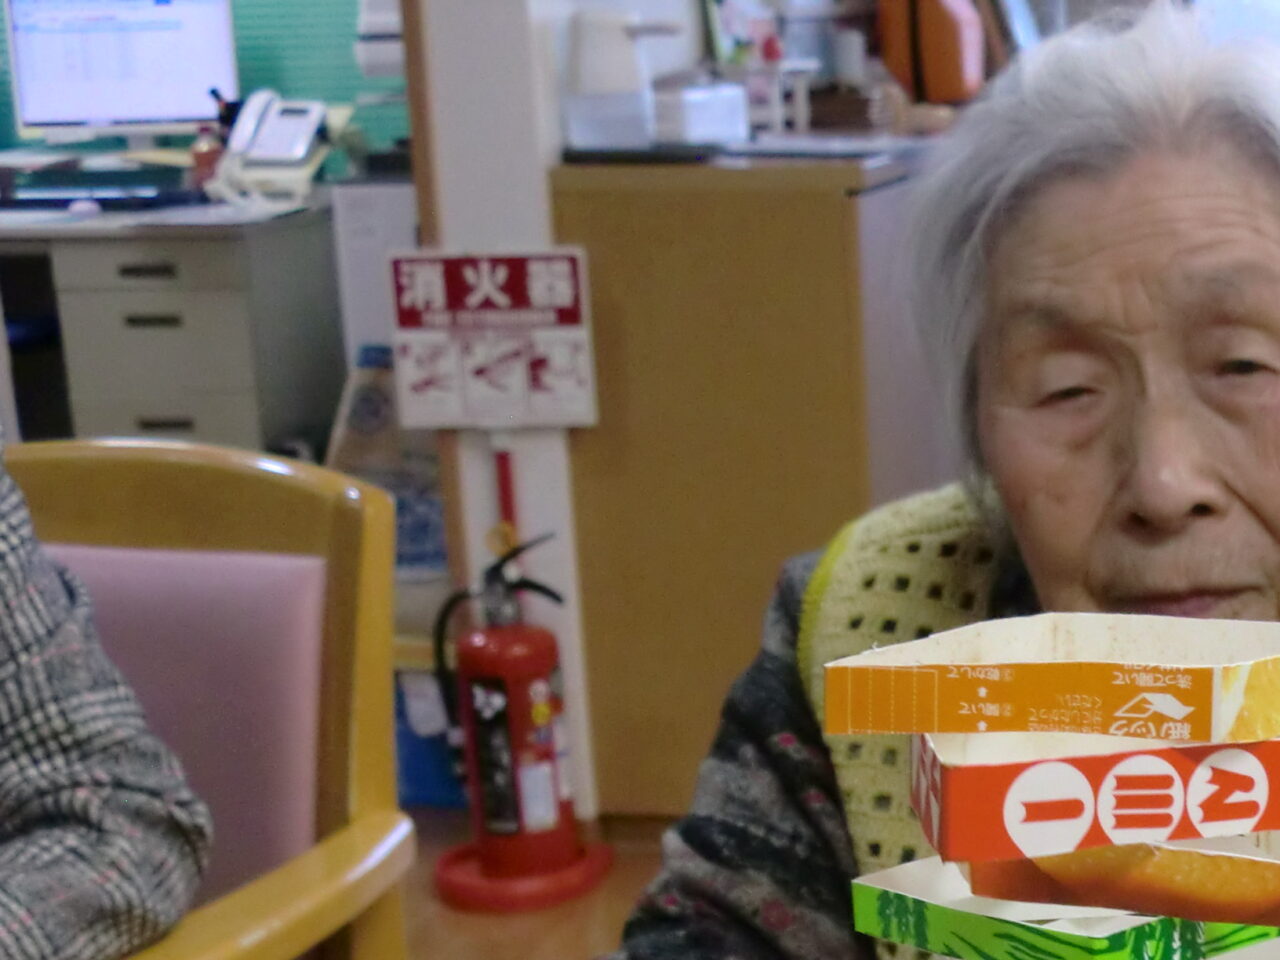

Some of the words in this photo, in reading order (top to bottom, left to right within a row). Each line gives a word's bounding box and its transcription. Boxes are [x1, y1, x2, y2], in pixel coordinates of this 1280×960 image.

[399, 259, 574, 310] 消火器
[1109, 719, 1192, 741] 紙パック
